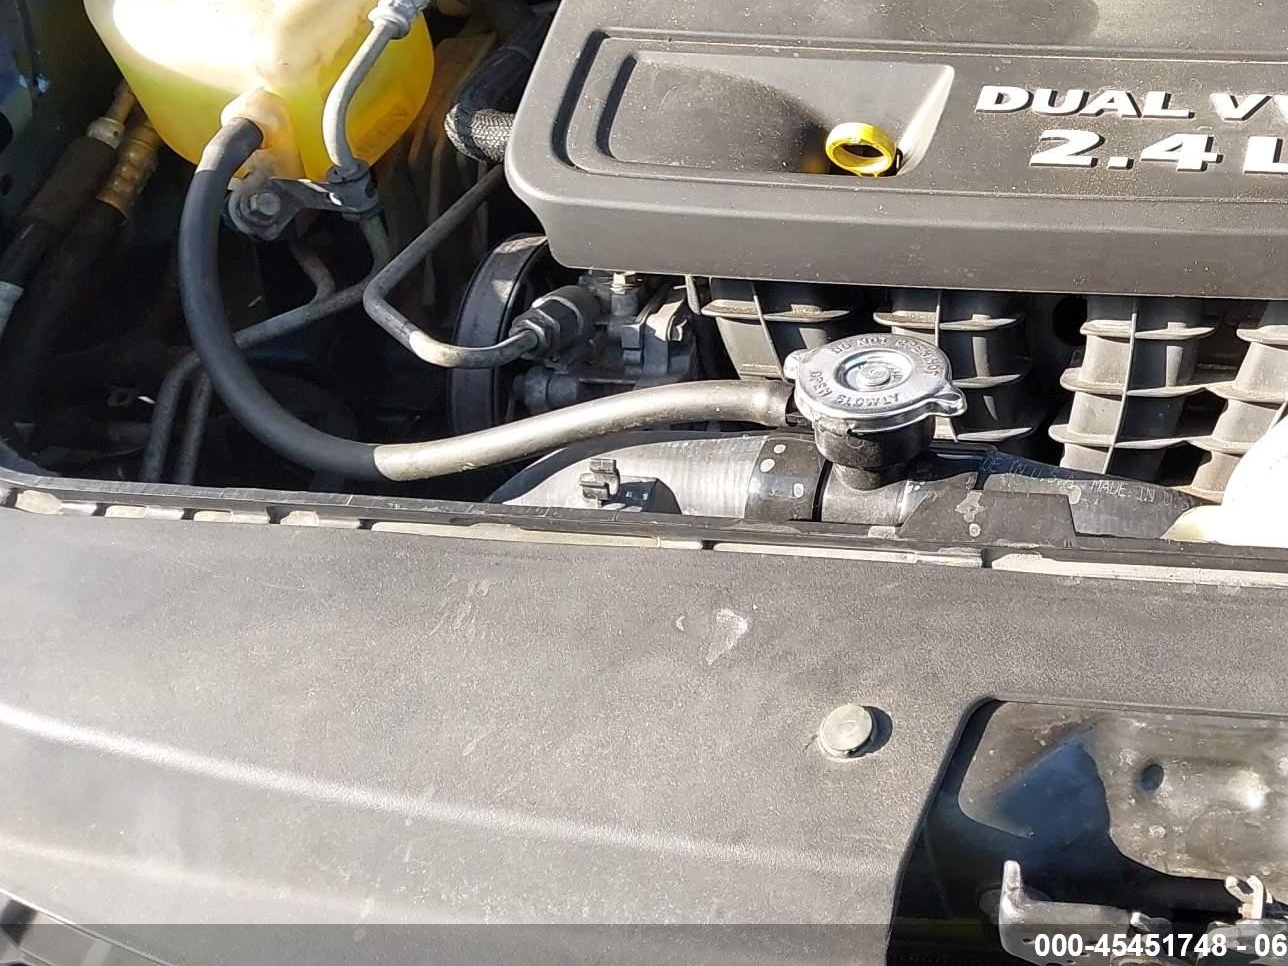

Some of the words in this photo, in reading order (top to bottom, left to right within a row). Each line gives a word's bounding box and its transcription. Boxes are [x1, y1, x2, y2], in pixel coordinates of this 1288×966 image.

[976, 85, 1194, 120] DUAL
[1029, 129, 1222, 172] 2.4
[856, 337, 889, 348] NOT
